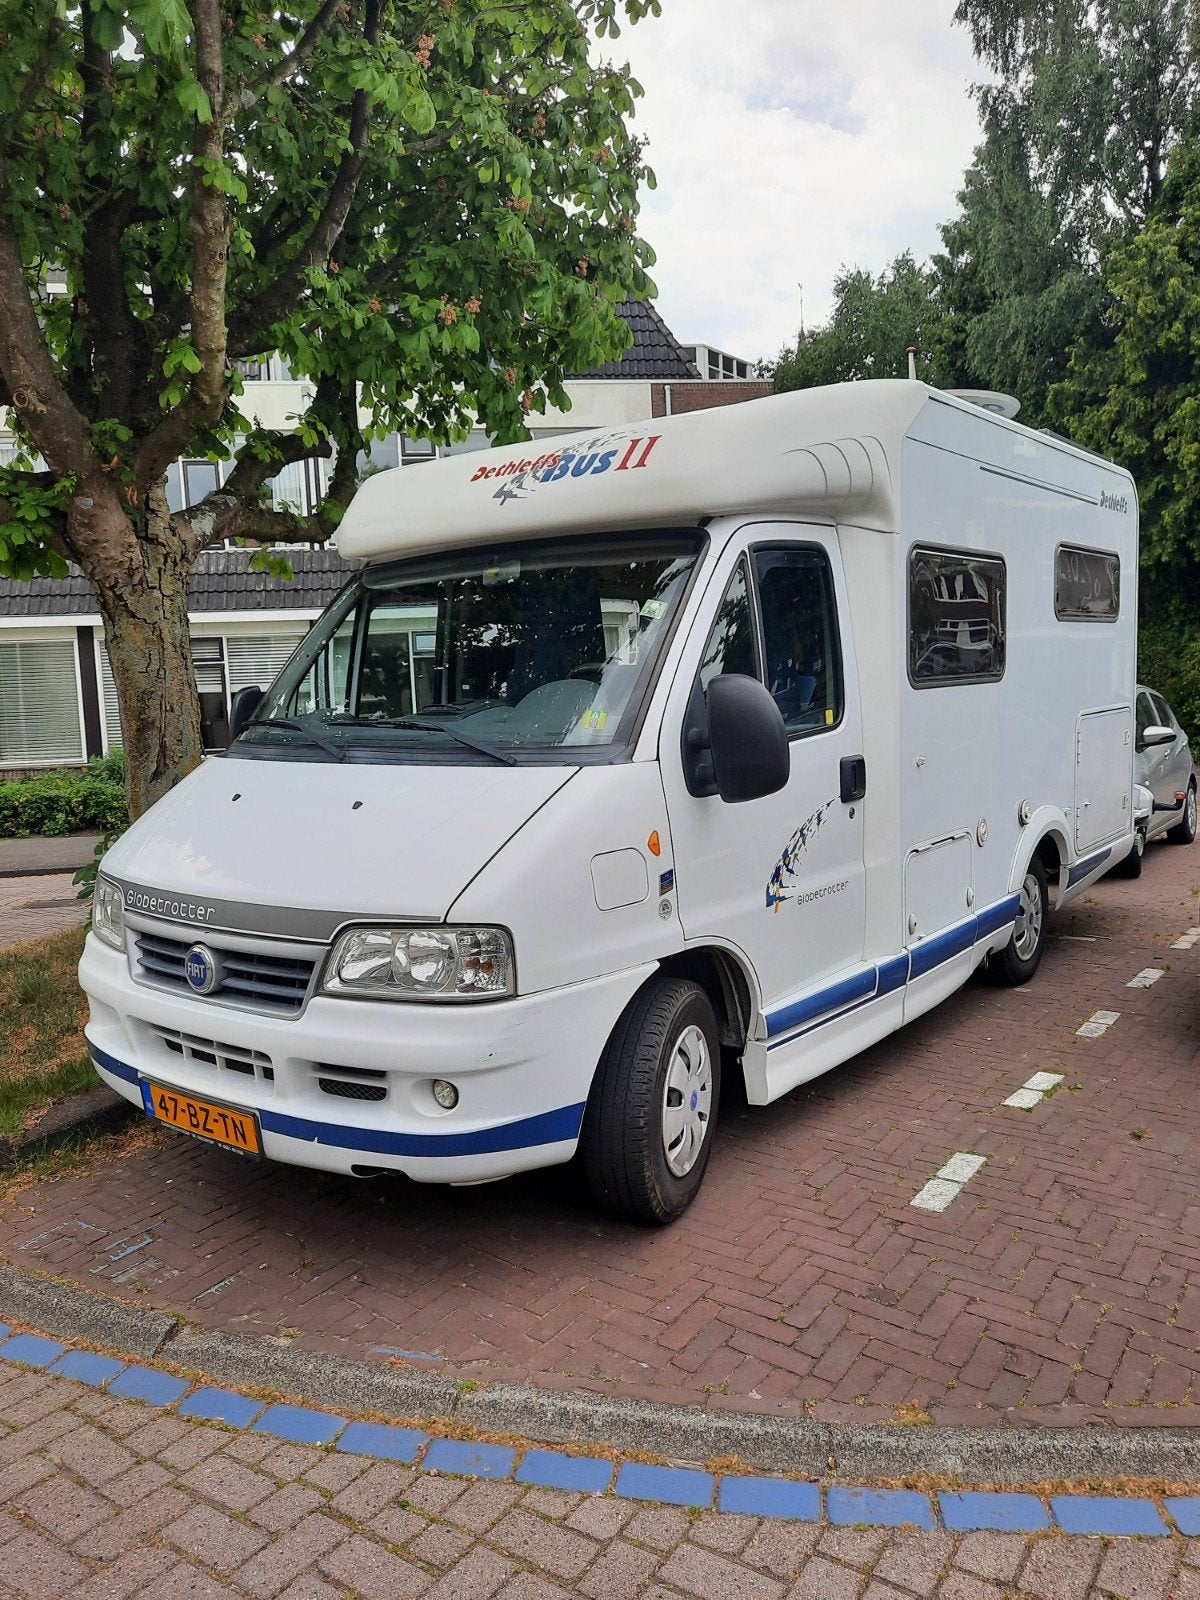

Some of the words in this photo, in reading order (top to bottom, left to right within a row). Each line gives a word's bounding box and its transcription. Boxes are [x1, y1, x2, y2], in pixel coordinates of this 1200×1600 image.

[470, 453, 561, 482] Dethleffs
[539, 449, 619, 483] BUS
[614, 435, 663, 472] II
[1099, 490, 1128, 514] Dethleffs
[126, 889, 216, 921] Globetrotter
[797, 880, 850, 906] Globetrotter
[187, 961, 206, 979] FIAT
[158, 1093, 248, 1146] 47-BZ-TN
